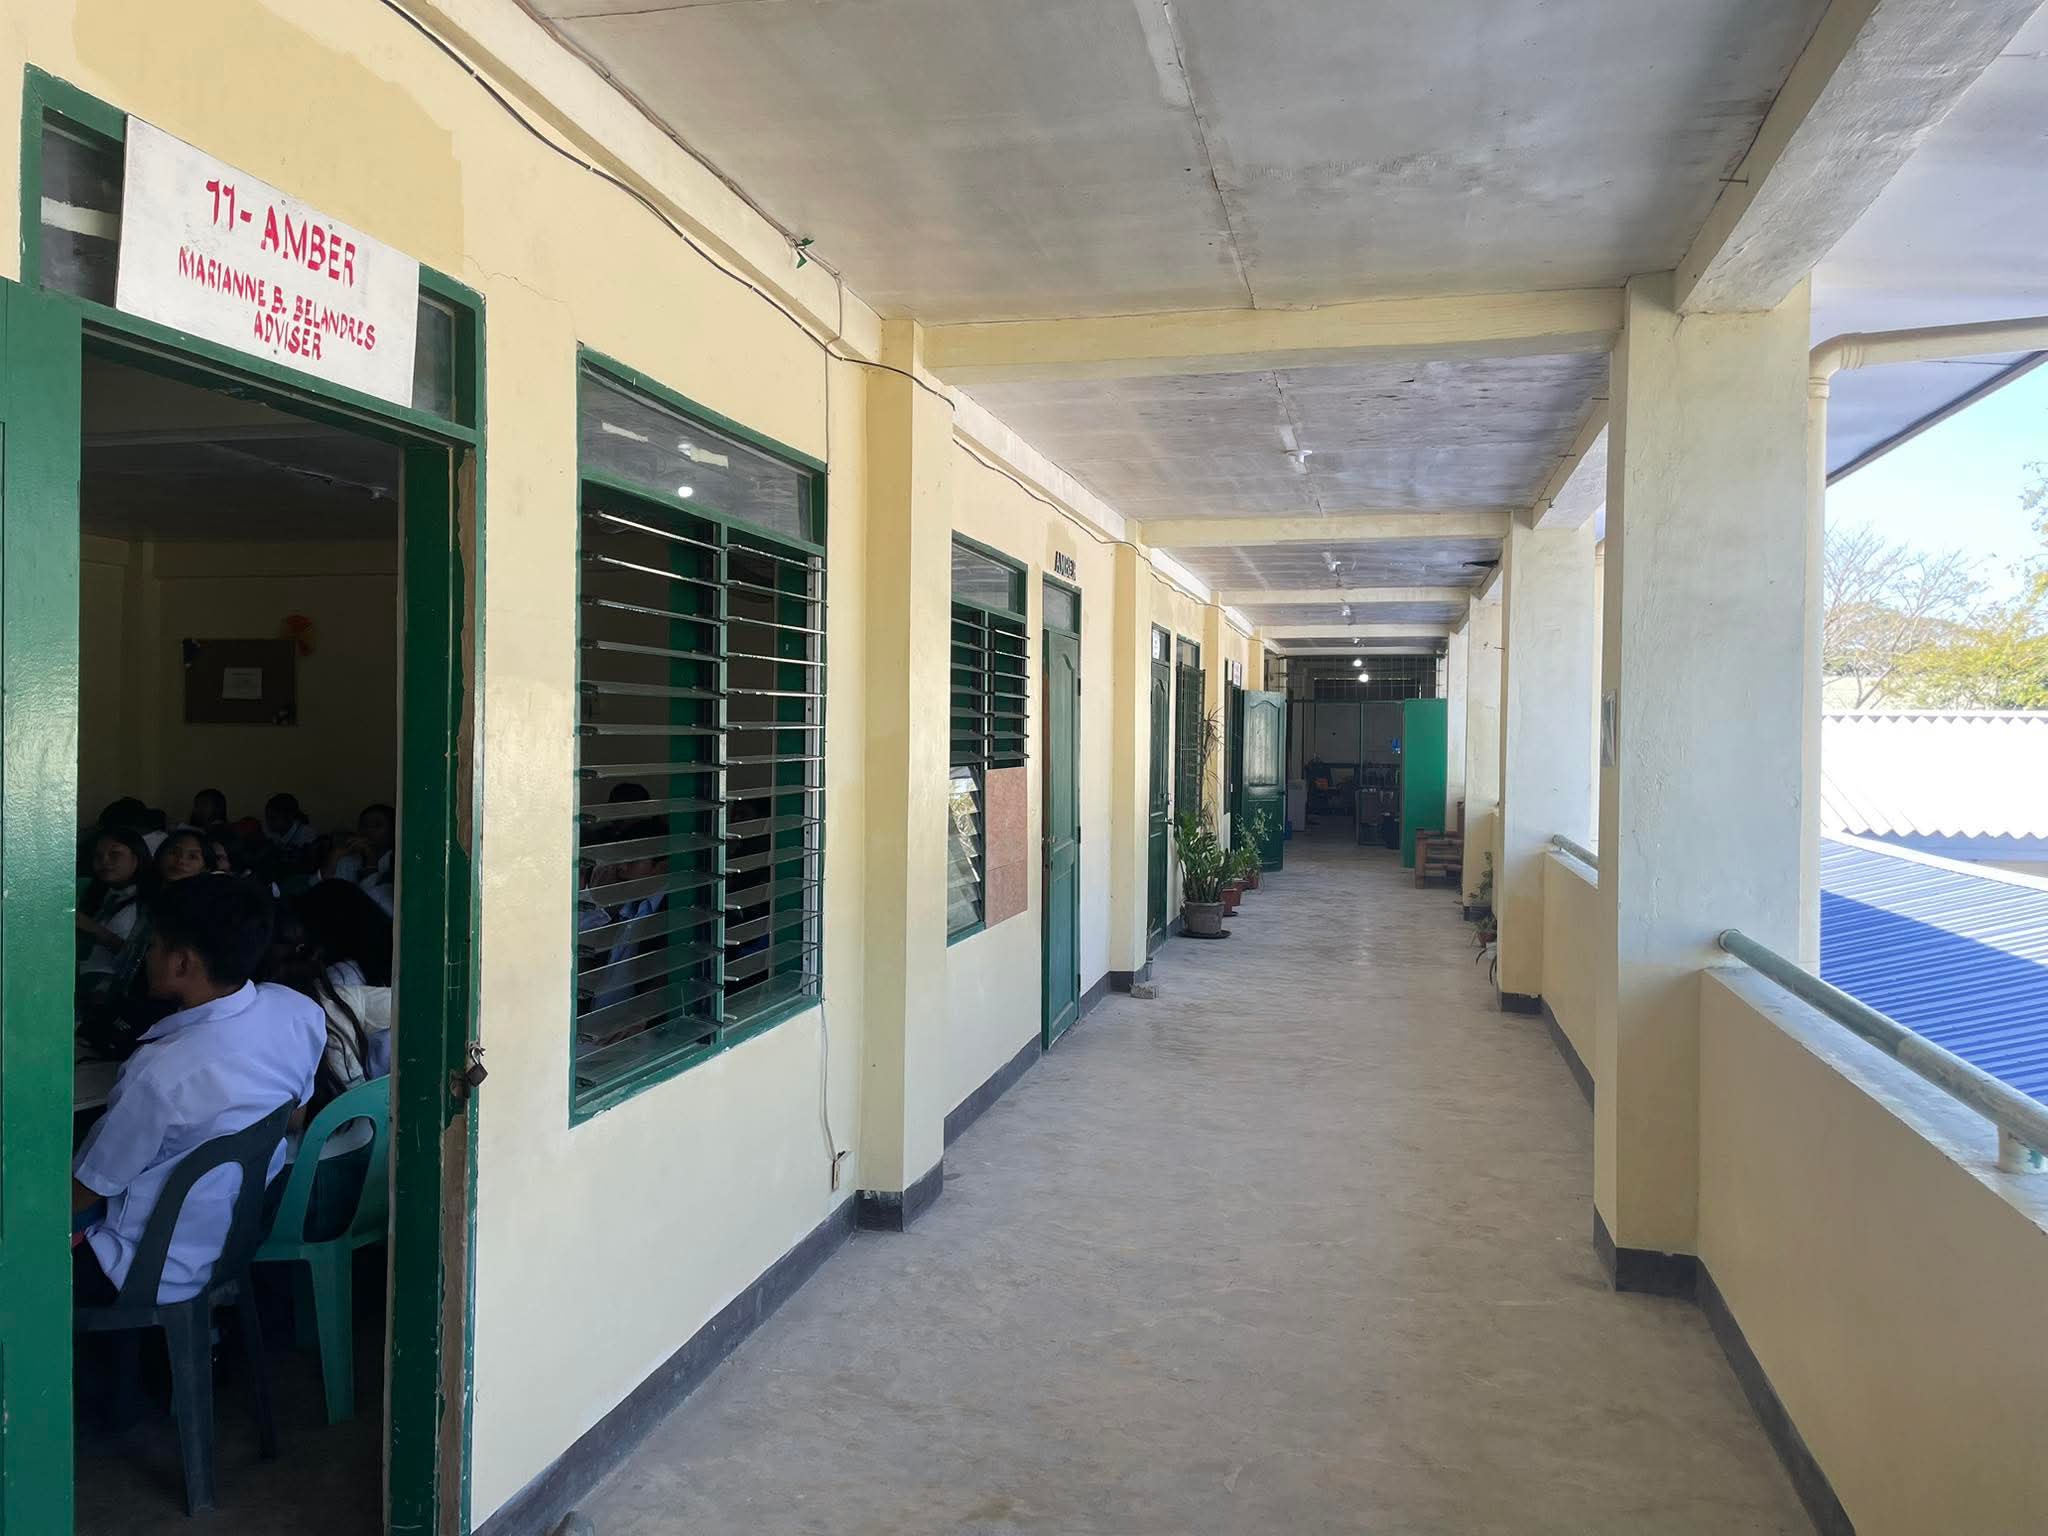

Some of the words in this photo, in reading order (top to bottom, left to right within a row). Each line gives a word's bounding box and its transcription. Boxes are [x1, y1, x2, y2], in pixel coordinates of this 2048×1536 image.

[178, 246, 267, 307] MARIANNE
[271, 285, 288, 315] B.
[261, 205, 357, 288] AMBER
[253, 310, 322, 361] ADVISER
